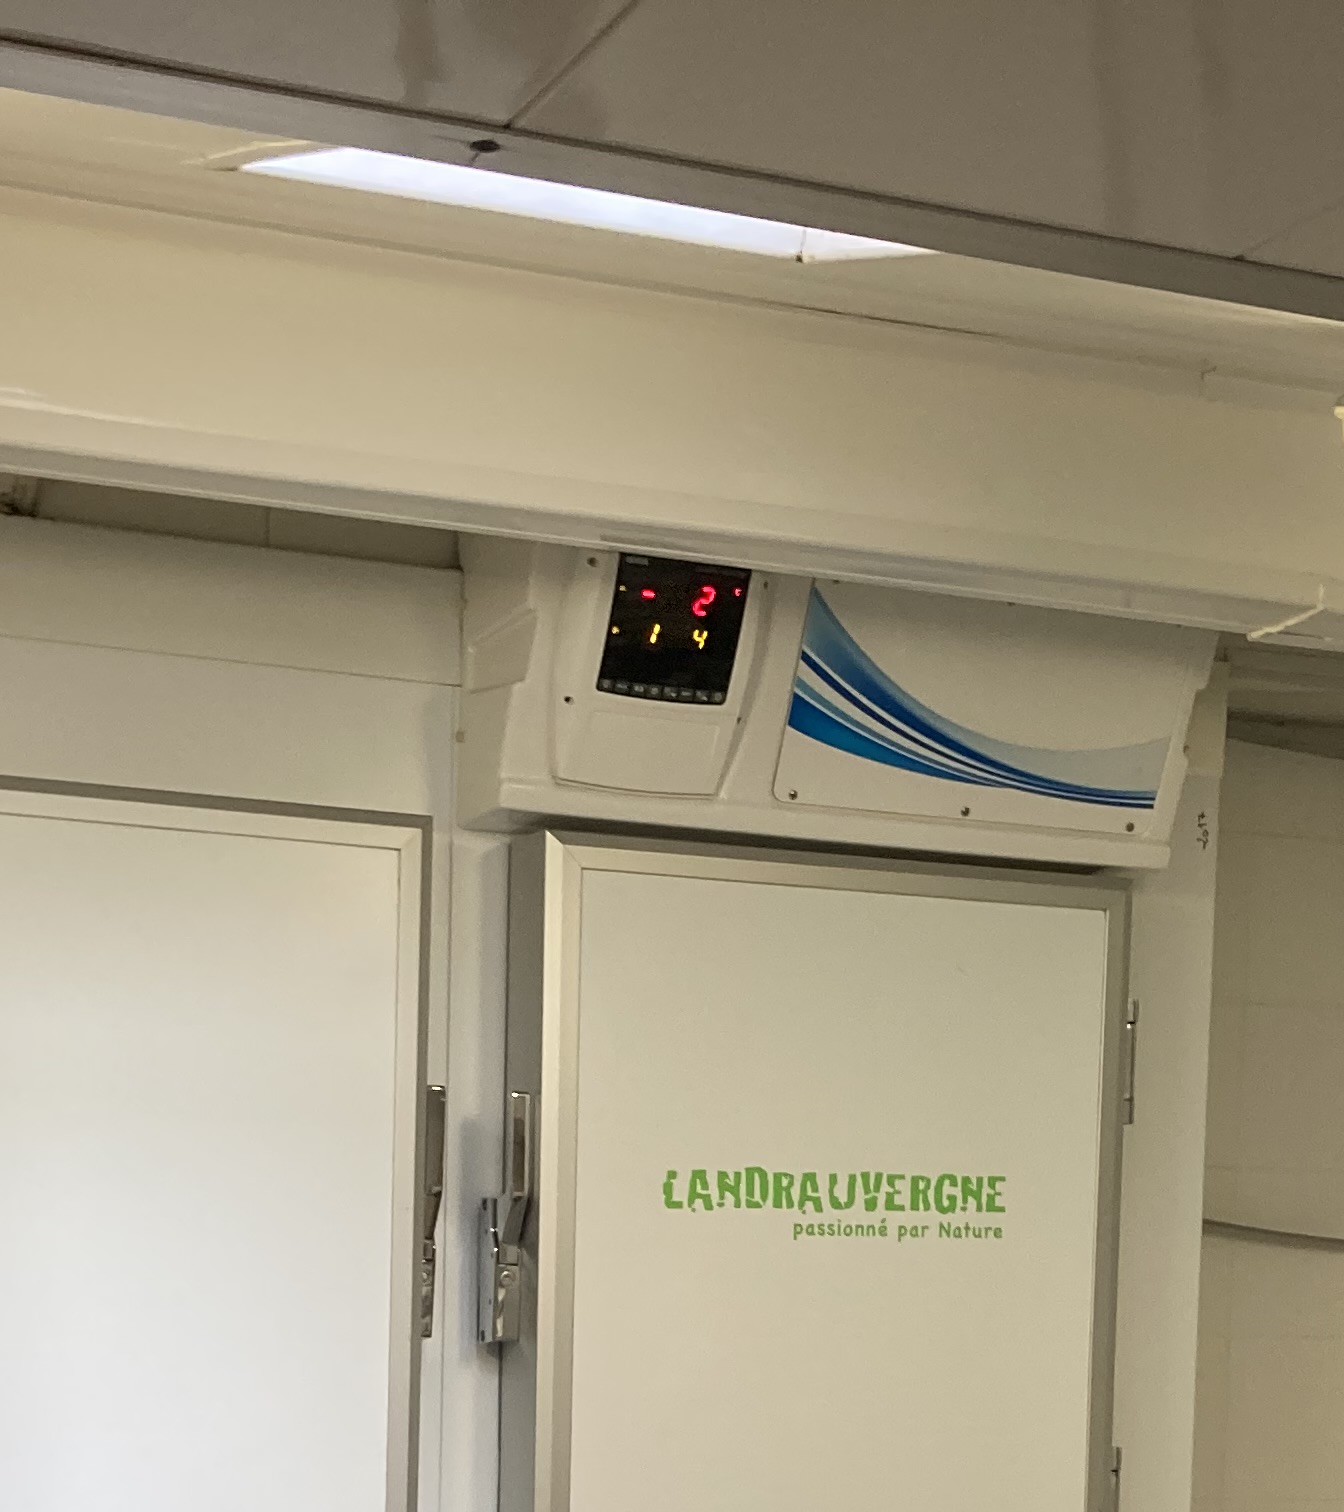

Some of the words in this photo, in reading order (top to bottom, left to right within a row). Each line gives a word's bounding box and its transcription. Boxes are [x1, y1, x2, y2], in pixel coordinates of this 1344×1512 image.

[663, 1167, 1006, 1214] LANDRAUVERGNE
[793, 1218, 888, 1241] passionné
[898, 1223, 929, 1241] par
[939, 1221, 1003, 1240] Nature
